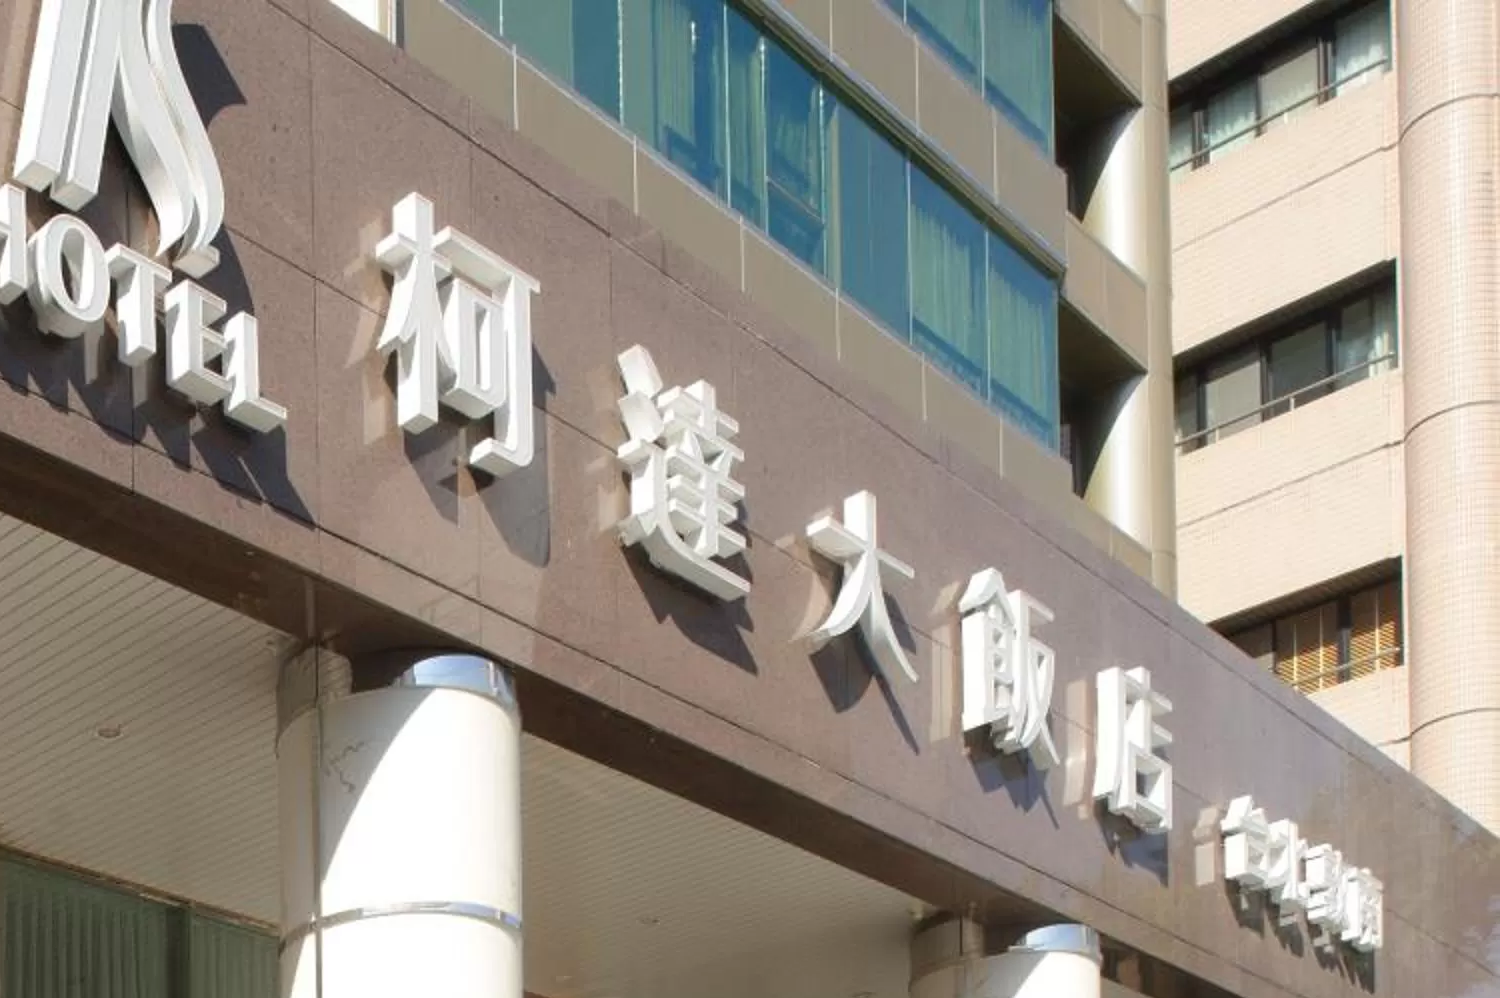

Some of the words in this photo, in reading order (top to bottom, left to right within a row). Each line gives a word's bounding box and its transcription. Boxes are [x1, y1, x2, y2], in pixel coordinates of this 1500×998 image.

[375, 191, 1174, 834] 柯達大飯店
